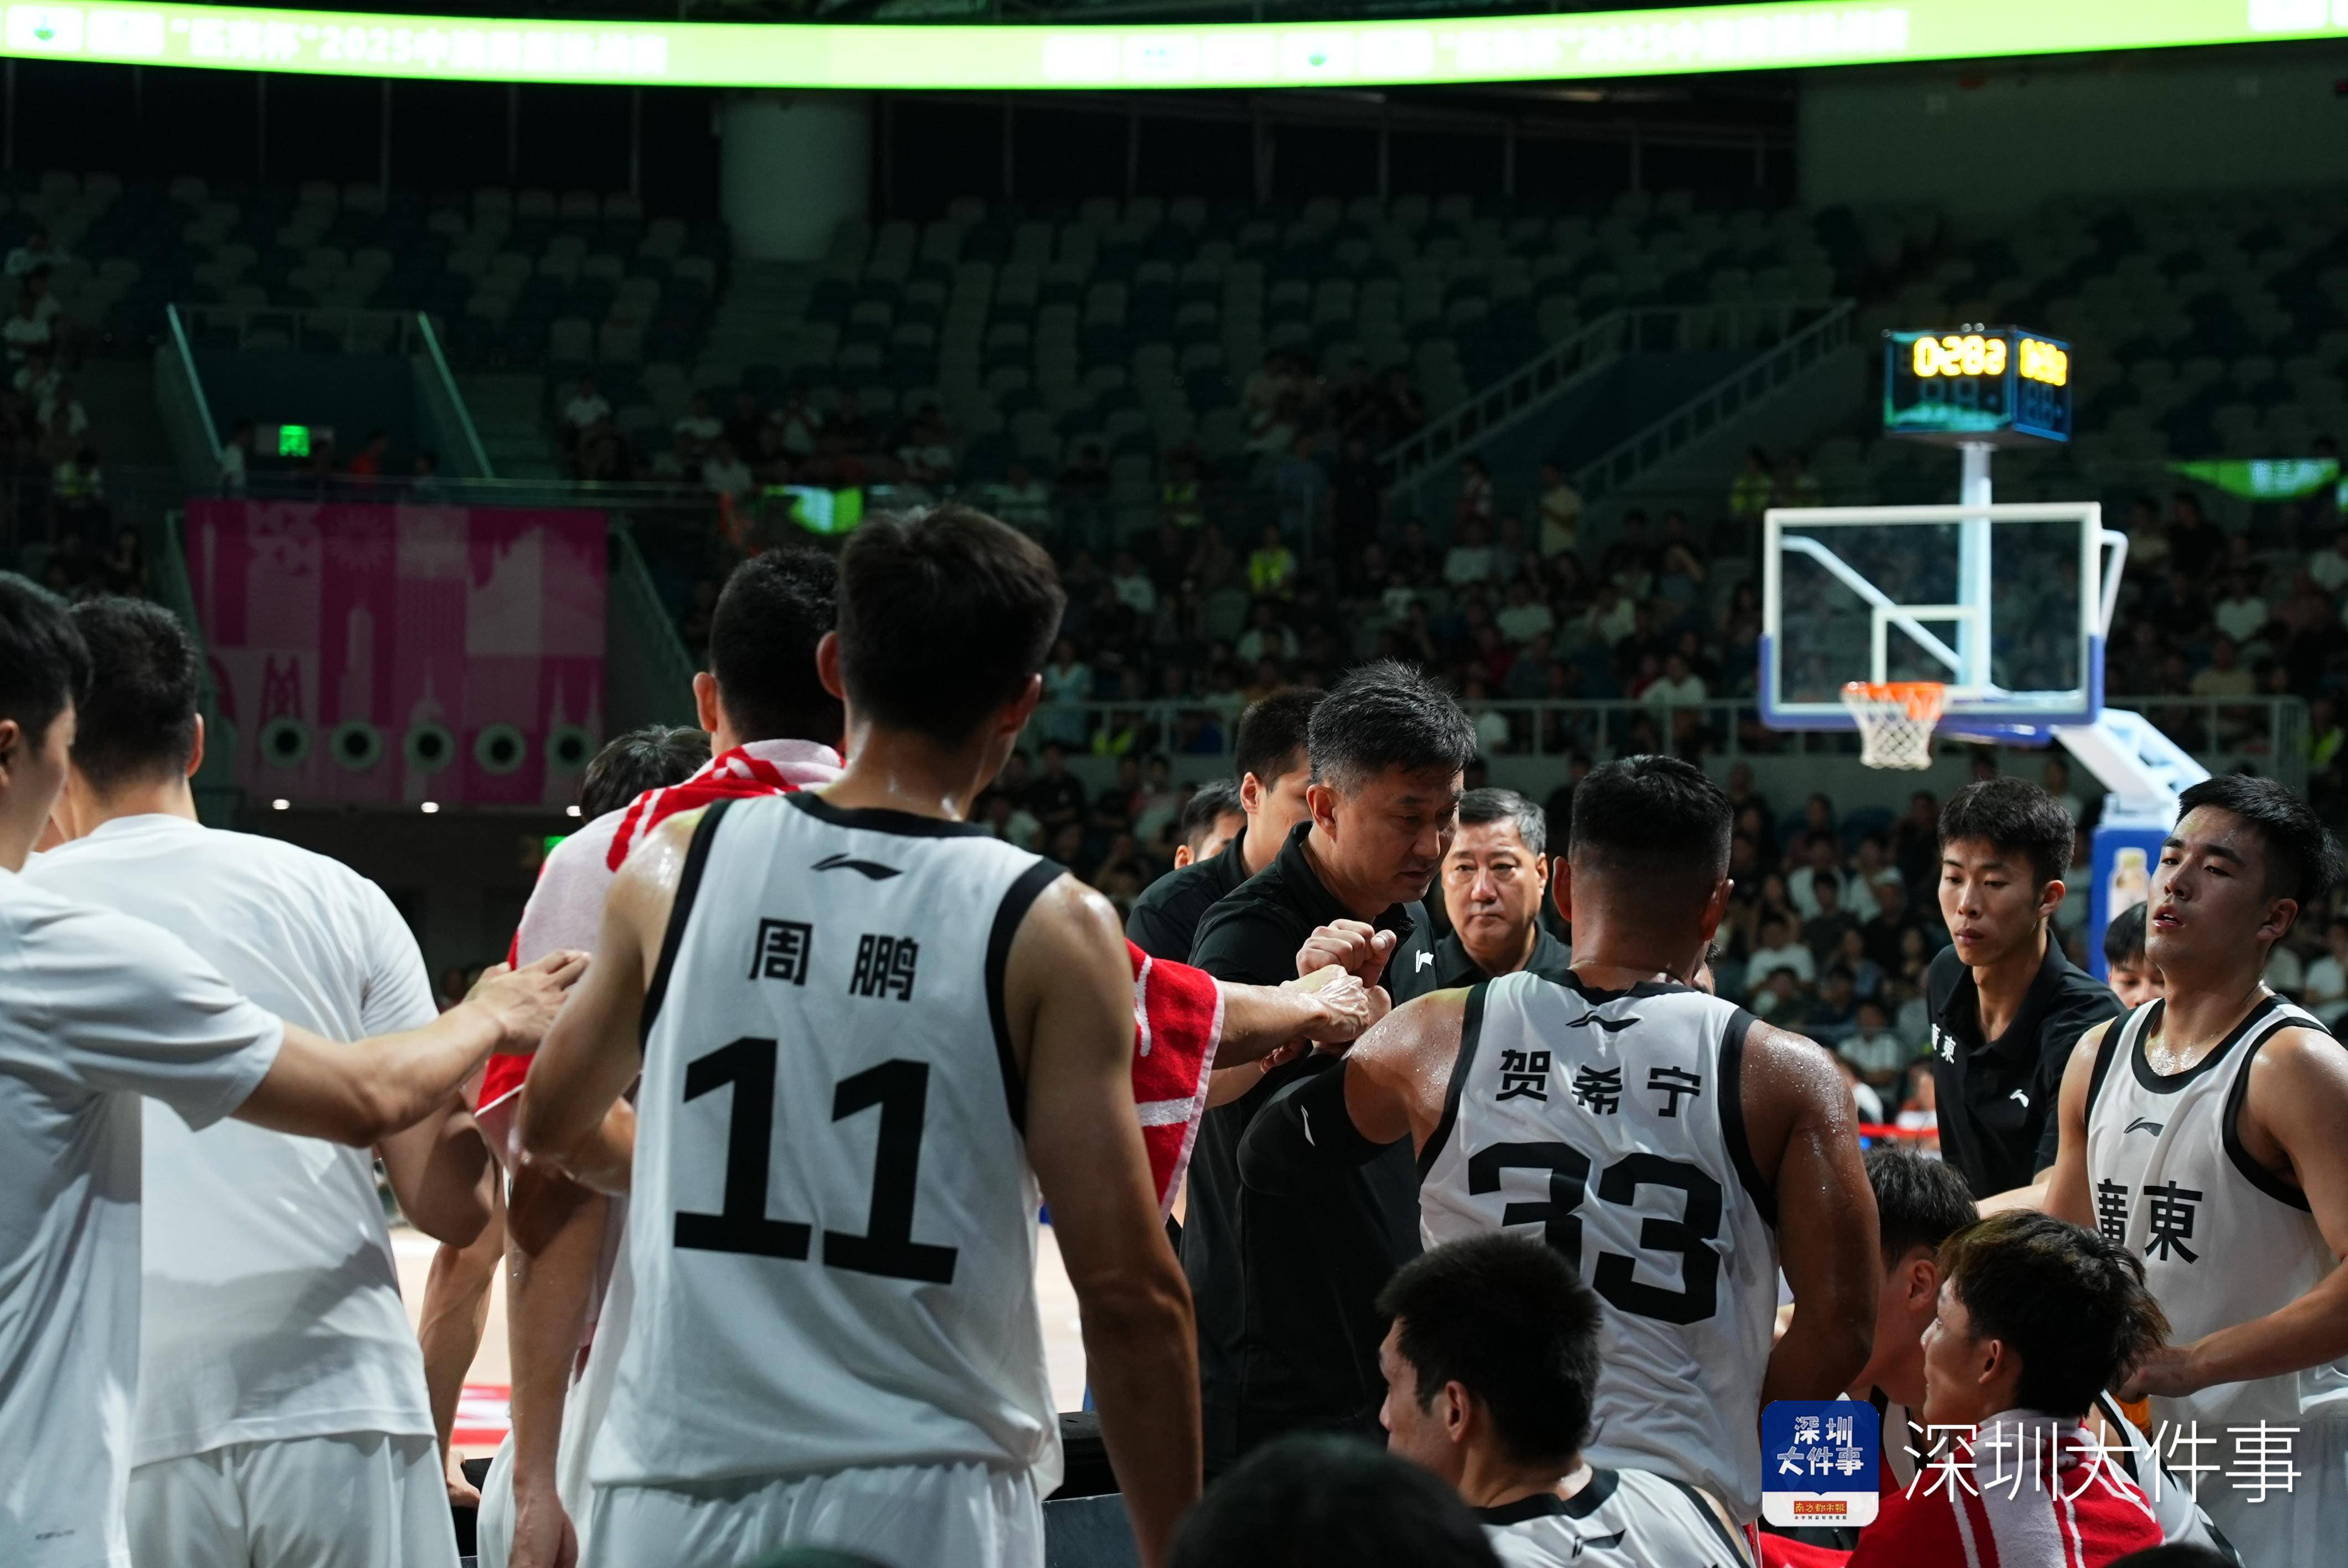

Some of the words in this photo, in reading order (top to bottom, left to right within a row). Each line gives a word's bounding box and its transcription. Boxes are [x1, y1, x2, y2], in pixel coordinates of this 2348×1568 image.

[748, 917, 920, 1001] 周鹏
[1496, 1049, 1701, 1117] 贺希宁
[673, 1036, 958, 1285] 11
[1468, 1142, 1722, 1325] 33
